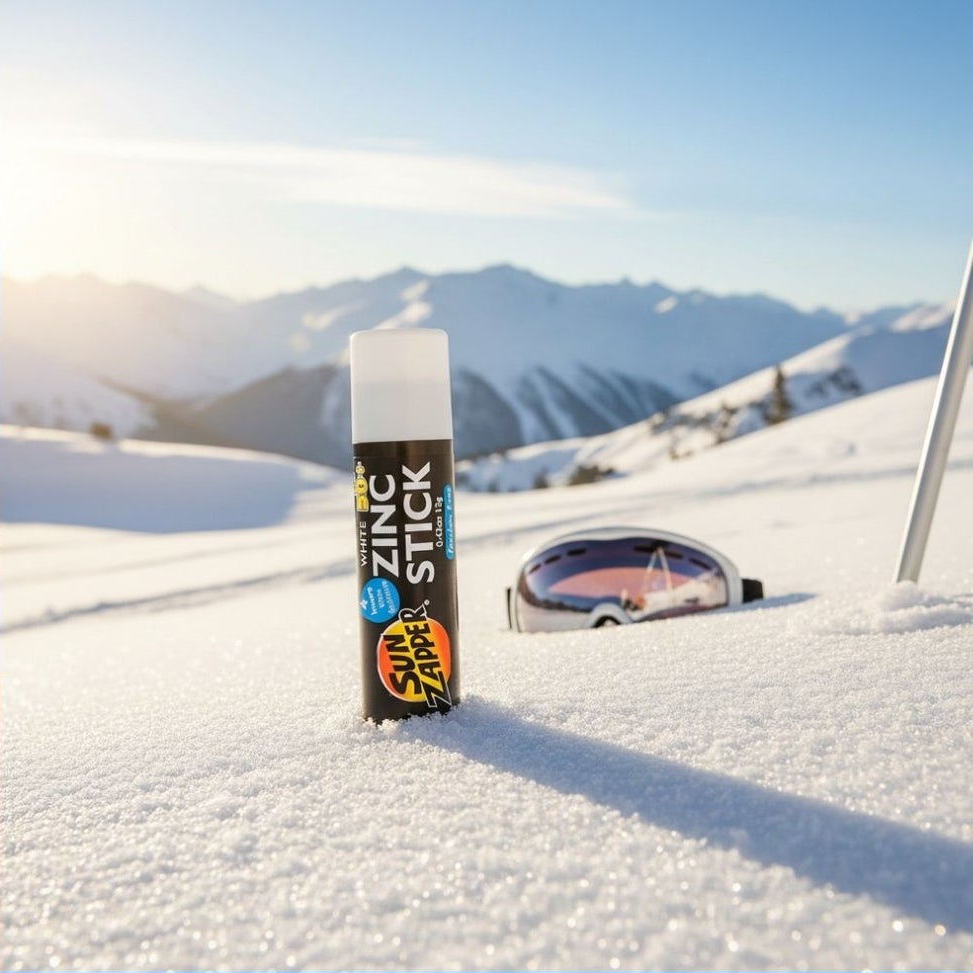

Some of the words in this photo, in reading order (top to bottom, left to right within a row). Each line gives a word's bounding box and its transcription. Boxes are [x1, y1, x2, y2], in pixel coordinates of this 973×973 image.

[359, 521, 367, 567] WHITE
[369, 474, 400, 578] ZINC
[401, 461, 435, 585] STICK
[382, 634, 421, 696] SUN
[399, 607, 453, 709] ZAPPER
